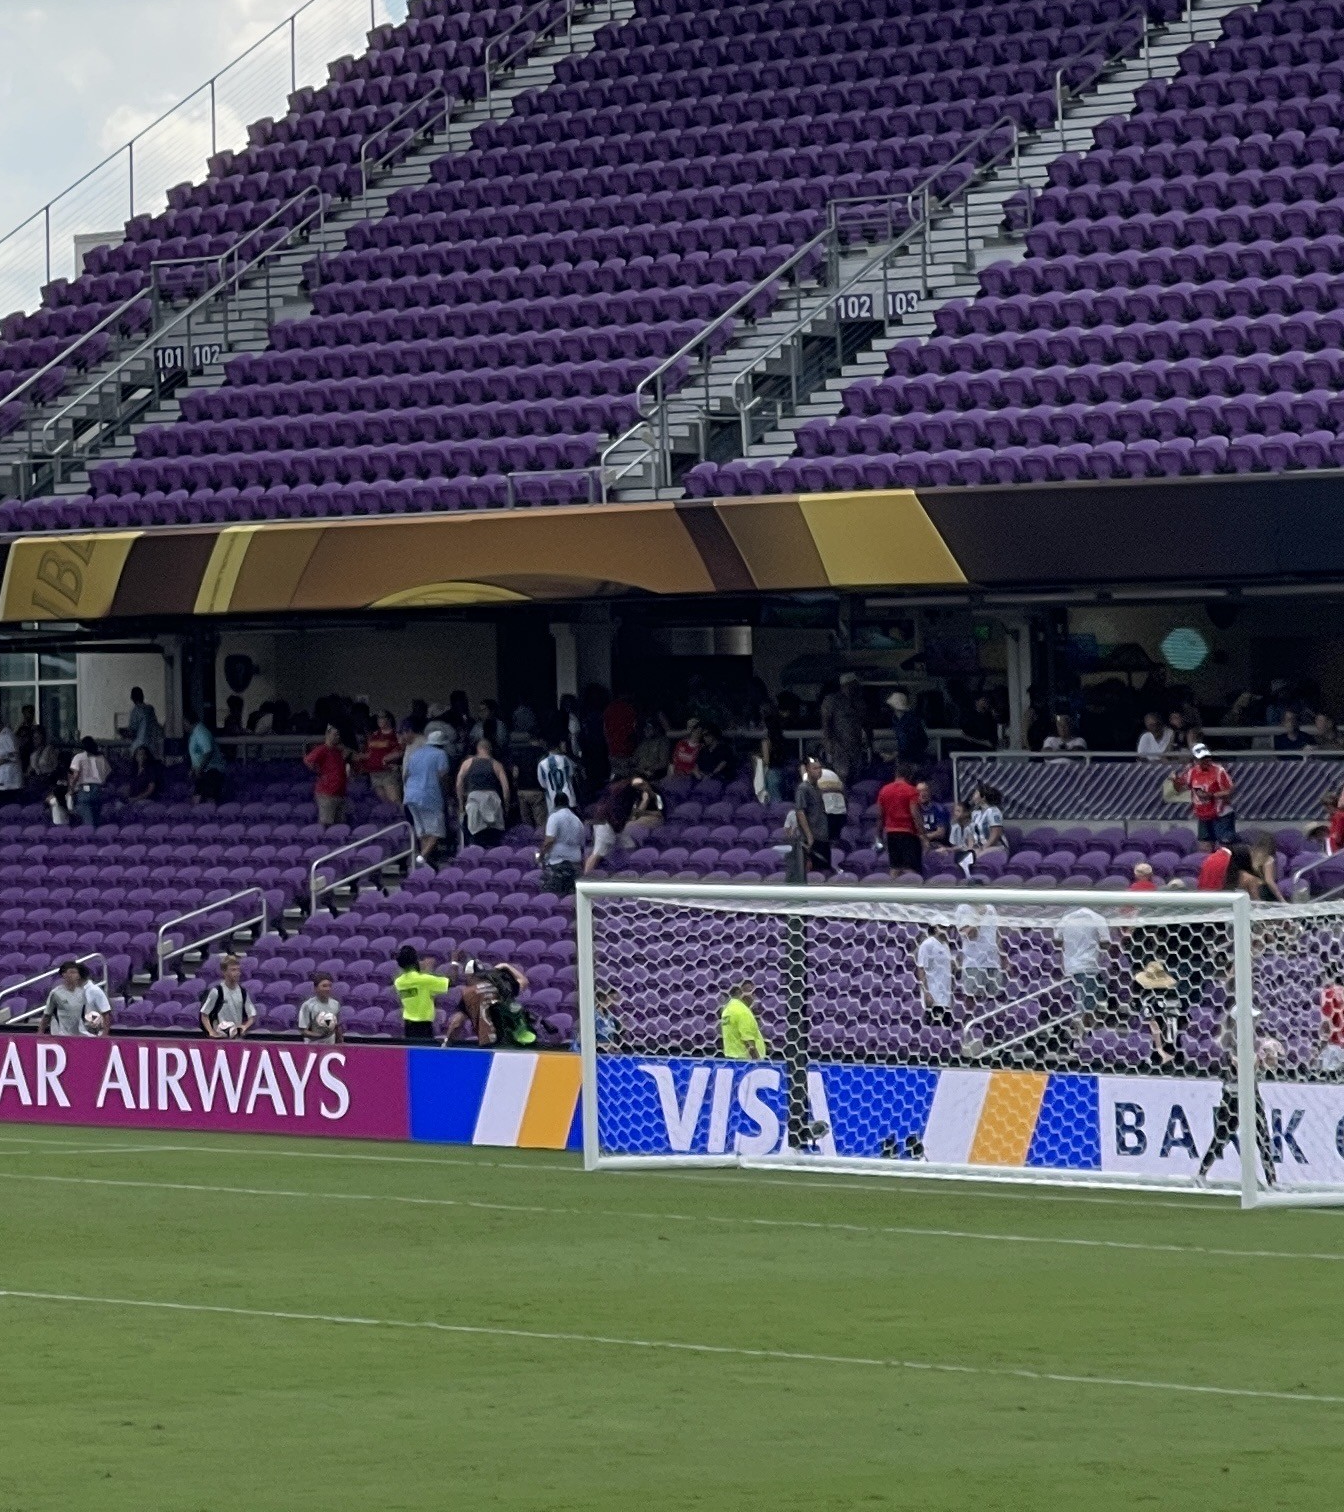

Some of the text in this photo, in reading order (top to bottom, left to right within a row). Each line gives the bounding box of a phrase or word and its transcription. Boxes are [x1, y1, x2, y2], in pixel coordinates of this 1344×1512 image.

[837, 296, 871, 319] 102
[888, 292, 918, 315] 103
[157, 347, 182, 368] 101
[193, 345, 220, 366] 102
[97, 1045, 351, 1120] AIRWAYS
